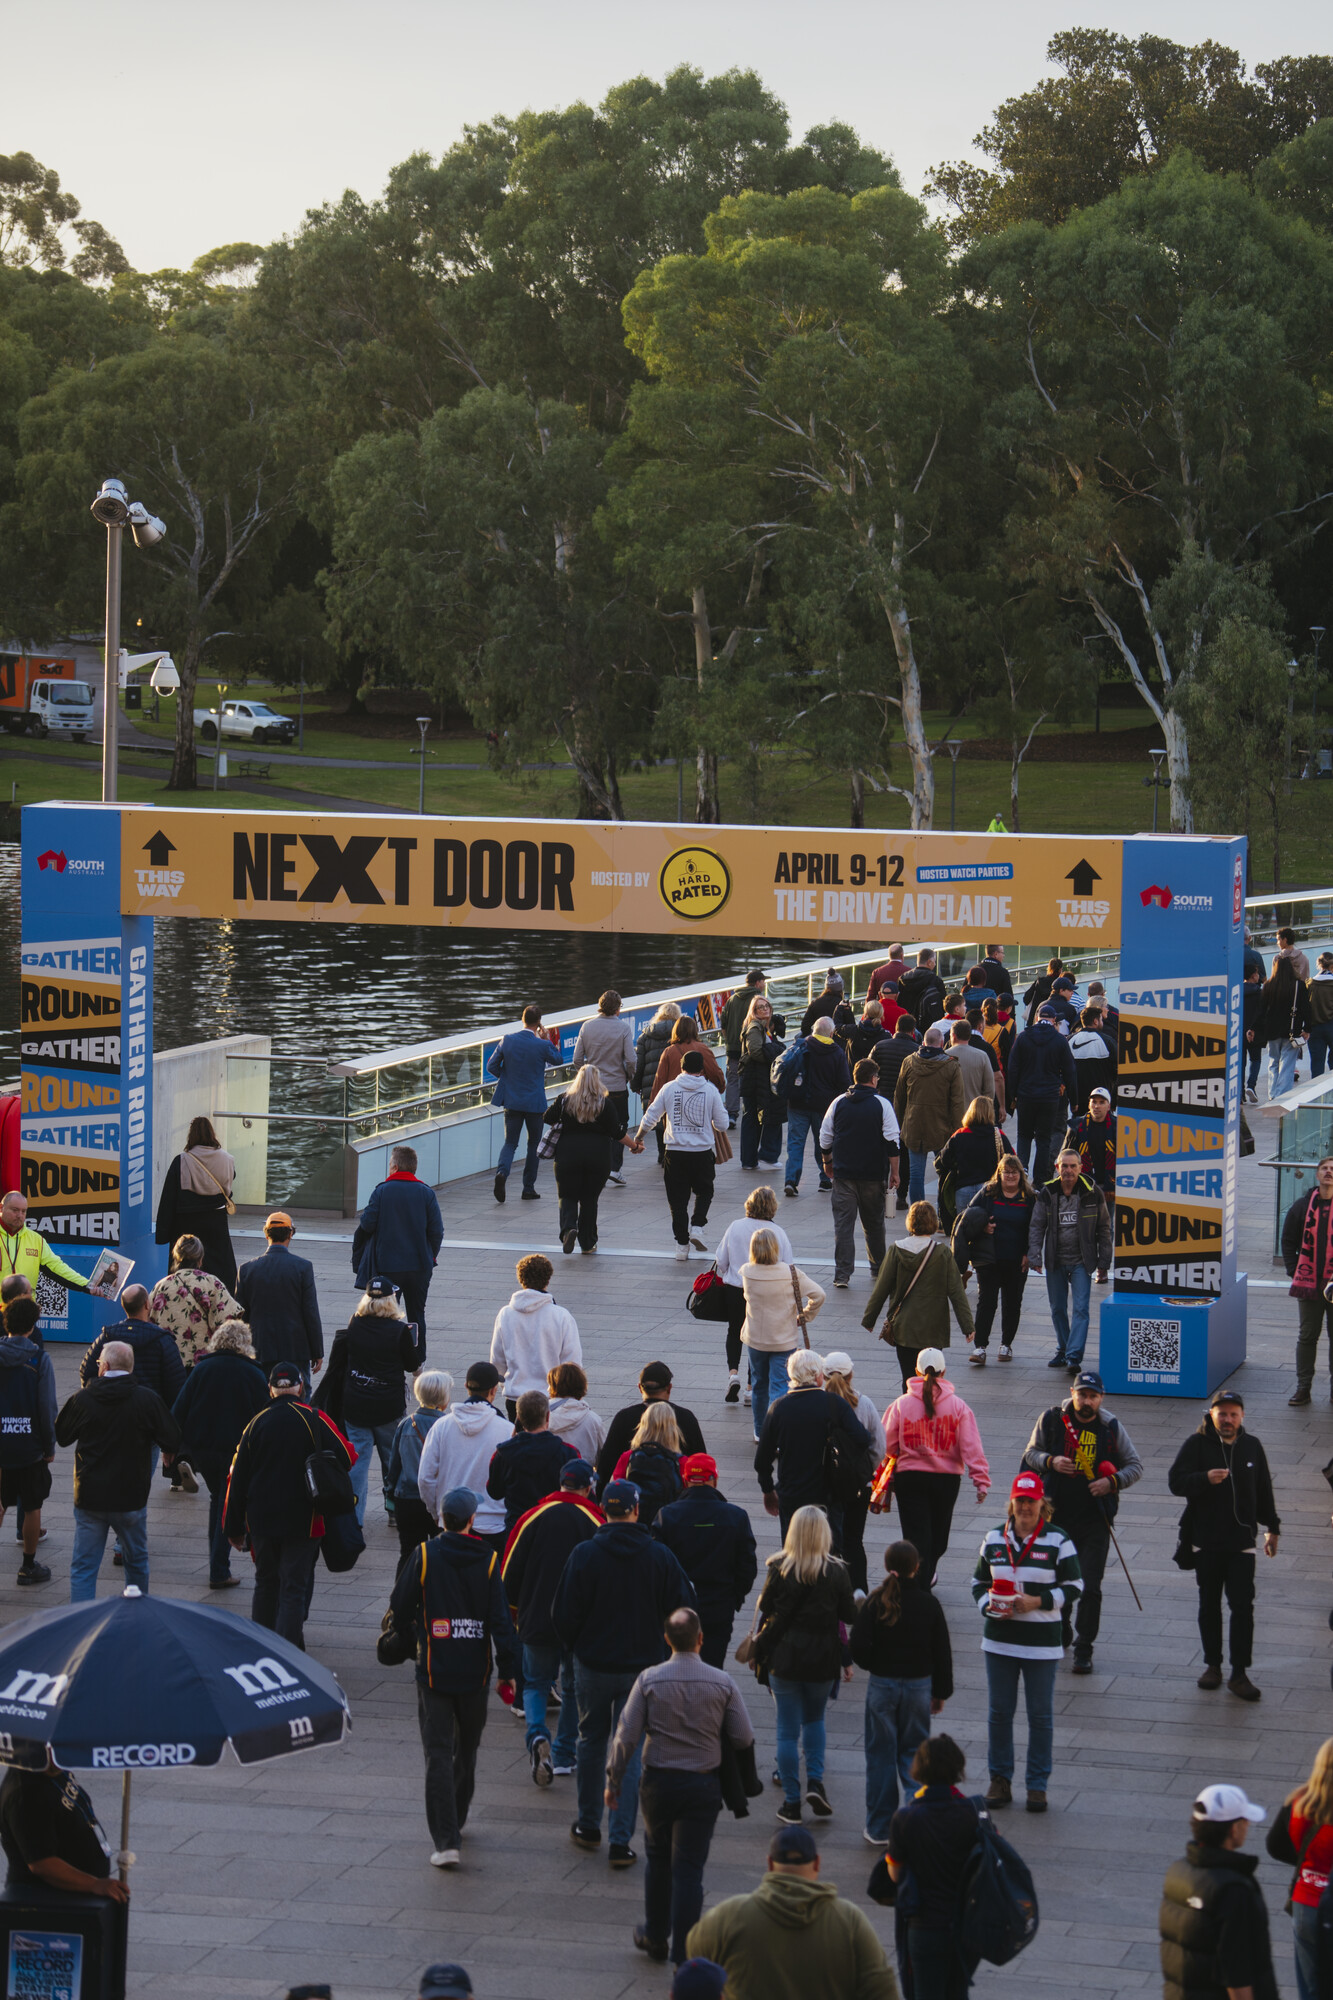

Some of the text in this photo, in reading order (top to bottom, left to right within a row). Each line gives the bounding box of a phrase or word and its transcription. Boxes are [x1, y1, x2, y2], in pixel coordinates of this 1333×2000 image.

[69, 859, 105, 870] SOUTH
[134, 869, 185, 884] THIS
[233, 831, 575, 911] NEXT DOOR
[591, 871, 650, 887] HOSTED BY
[774, 852, 905, 887] APRIL 9-12
[920, 866, 1010, 880] HOSTED WATCH PARTIES
[136, 883, 183, 898] WAY
[671, 884, 722, 903] RATED
[678, 874, 711, 886] HARD
[773, 889, 1012, 928] THE DRIVE ADELAIDE
[1056, 899, 1111, 914] THIS
[1173, 895, 1213, 906] SOUTH
[1058, 914, 1107, 928] WAY
[21, 946, 121, 976] GATHER
[21, 981, 121, 1024] ROUND
[1119, 985, 1227, 1015] GATHER
[21, 1035, 121, 1065] GATHER
[1118, 1021, 1226, 1065] ROUND
[127, 945, 147, 1208] GATHER ROUND
[21, 1071, 121, 1114] ROUND
[1117, 1077, 1225, 1109] GATHER
[673, 1090, 682, 1126] ALTERNATE
[1224, 984, 1241, 1257] GATHER ROUND
[21, 1122, 120, 1152] GATHER
[1116, 1114, 1224, 1158] ROUND
[21, 1157, 120, 1199] ROUND
[1116, 1168, 1223, 1199] GATHER
[25, 1211, 120, 1241] GATHER
[1062, 1213, 1078, 1222] AIG
[1115, 1203, 1222, 1247] ROUND
[1114, 1261, 1222, 1292] GATHER
[50, 1320, 69, 1330] MORE
[1127, 1372, 1180, 1384] FIND OUT MORE
[451, 1618, 483, 1628] HUNGRY
[254, 1688, 311, 1709] metricon
[92, 1742, 197, 1767] RECORD
[16, 1957, 74, 1972] RECORD
